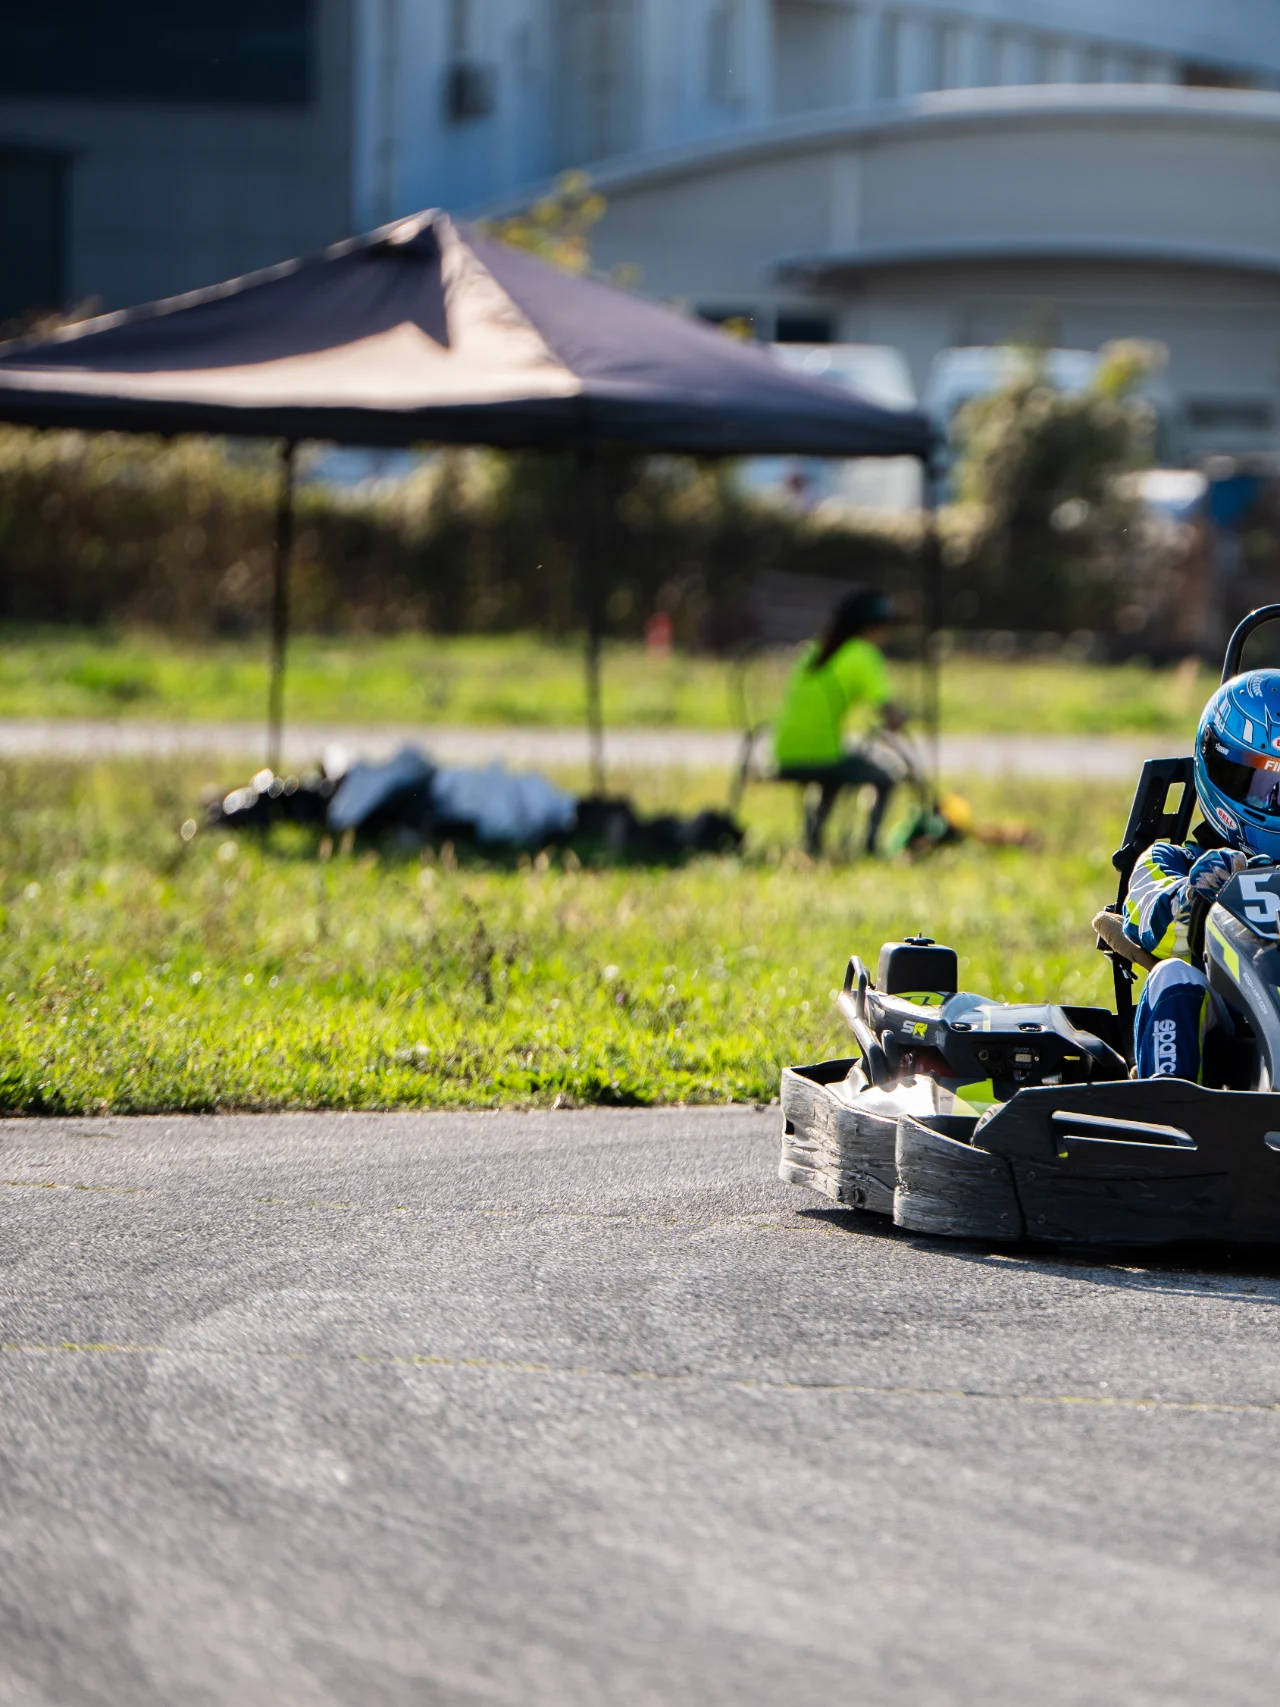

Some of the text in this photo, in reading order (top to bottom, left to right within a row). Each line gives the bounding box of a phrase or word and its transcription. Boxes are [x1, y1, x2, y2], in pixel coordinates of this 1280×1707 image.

[1217, 809, 1234, 828] BELL
[900, 1019, 928, 1037] SR
[1152, 1018, 1177, 1075] sparc
